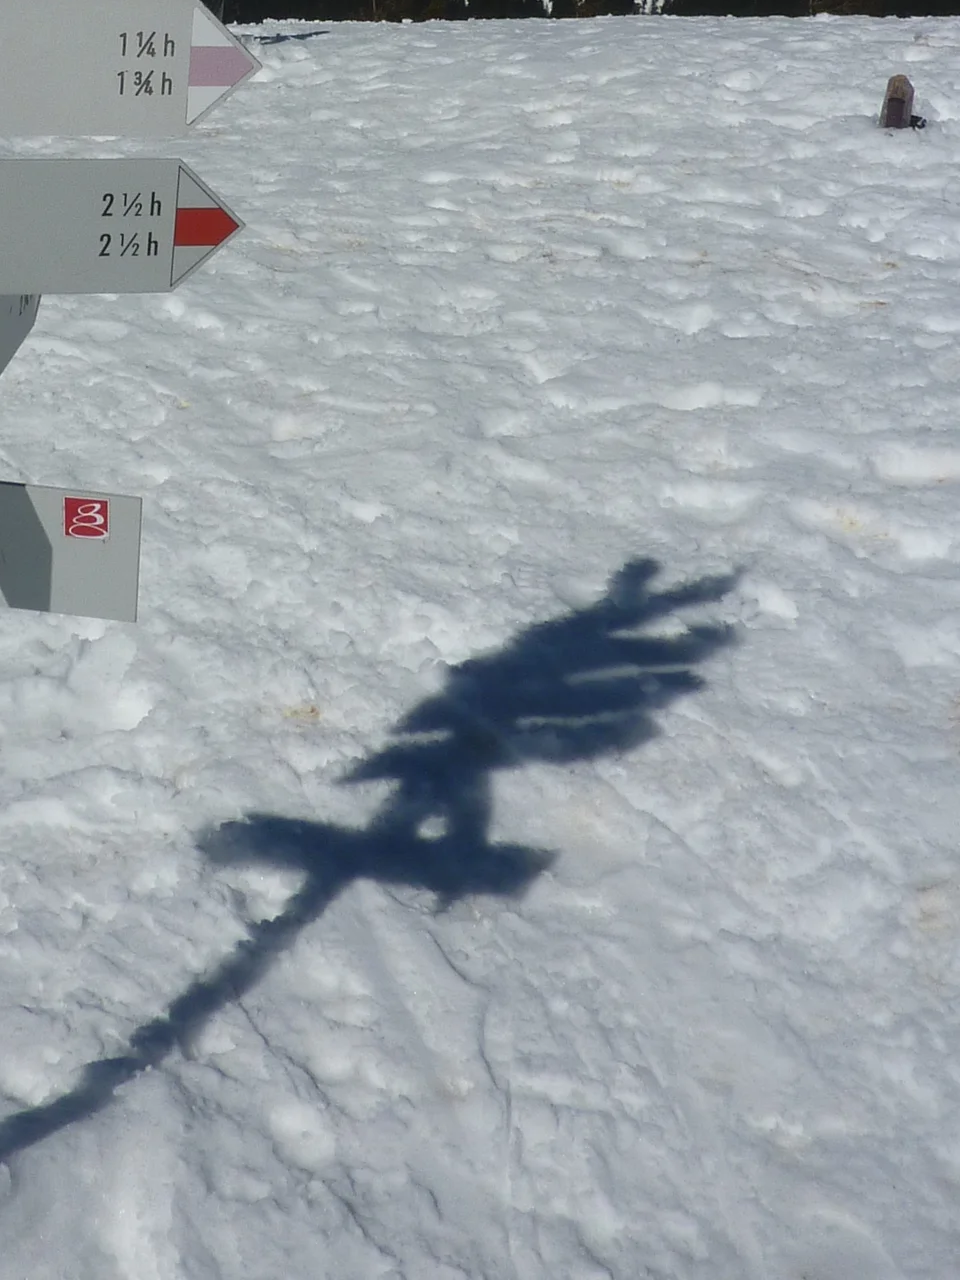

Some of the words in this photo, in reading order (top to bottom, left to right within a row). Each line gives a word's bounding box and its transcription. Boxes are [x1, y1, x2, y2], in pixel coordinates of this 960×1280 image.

[163, 32, 176, 57] h
[161, 71, 173, 95] h
[150, 191, 162, 216] h
[147, 231, 159, 256] h
